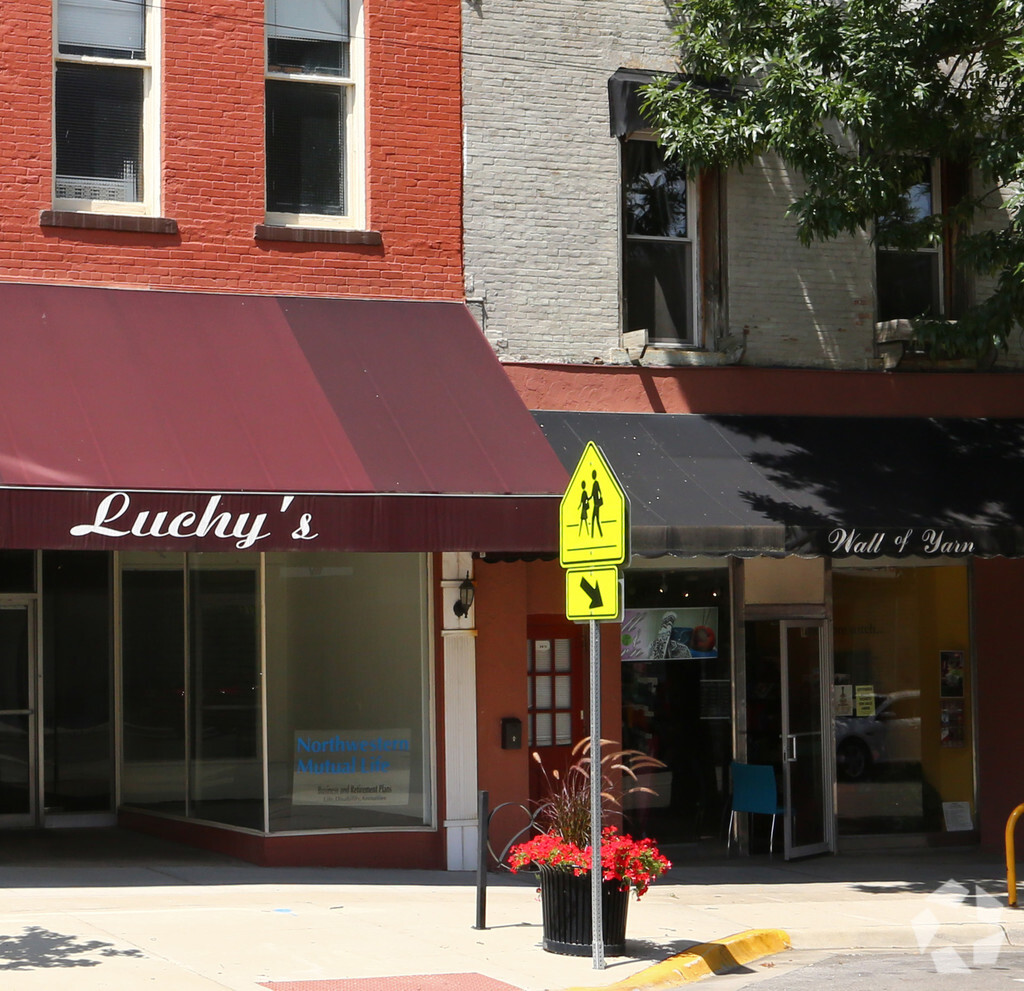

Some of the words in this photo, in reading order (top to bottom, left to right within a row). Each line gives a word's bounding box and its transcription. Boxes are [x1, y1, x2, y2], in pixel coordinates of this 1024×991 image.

[70, 492, 319, 549] Luchy's
[828, 528, 885, 553] Wall
[894, 529, 913, 553] of
[922, 529, 976, 553] Yarn
[297, 735, 409, 753] Northwestern
[297, 756, 356, 774] Mutual
[361, 755, 391, 774] Life
